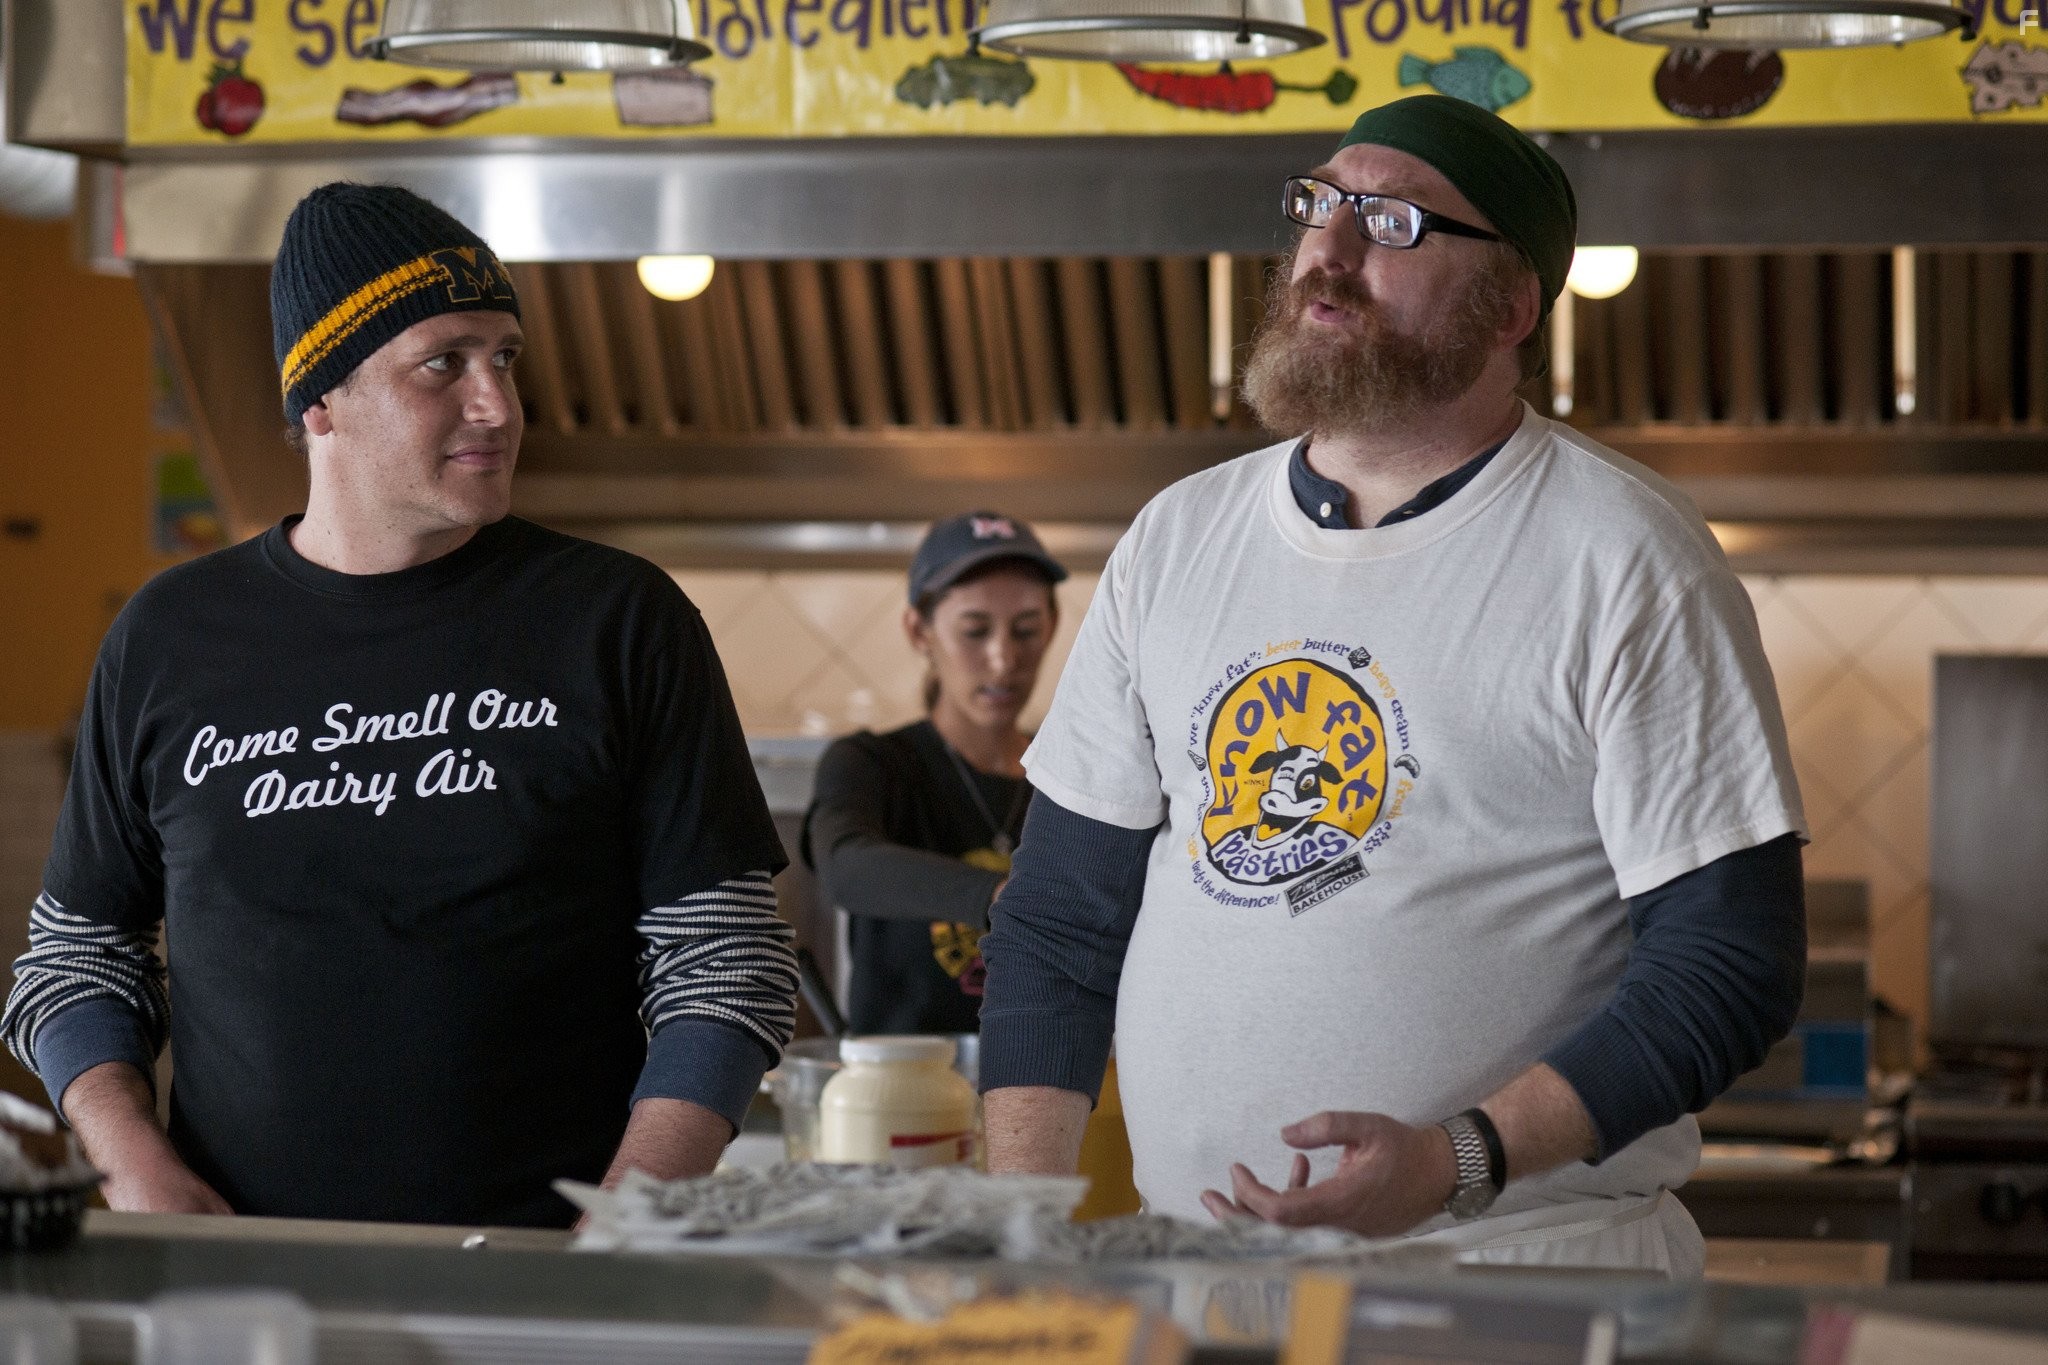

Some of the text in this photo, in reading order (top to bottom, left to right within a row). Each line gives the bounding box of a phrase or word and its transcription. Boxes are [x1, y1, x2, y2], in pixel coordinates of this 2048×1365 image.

[1302, 638, 1351, 657] butter
[183, 687, 560, 787] Come Smell Our
[1391, 699, 1410, 753] cream
[243, 747, 498, 819] Dairy Air
[1214, 830, 1348, 878] pastries
[1213, 888, 1280, 909] difference!
[1292, 870, 1366, 914] BAKEHOUSE
